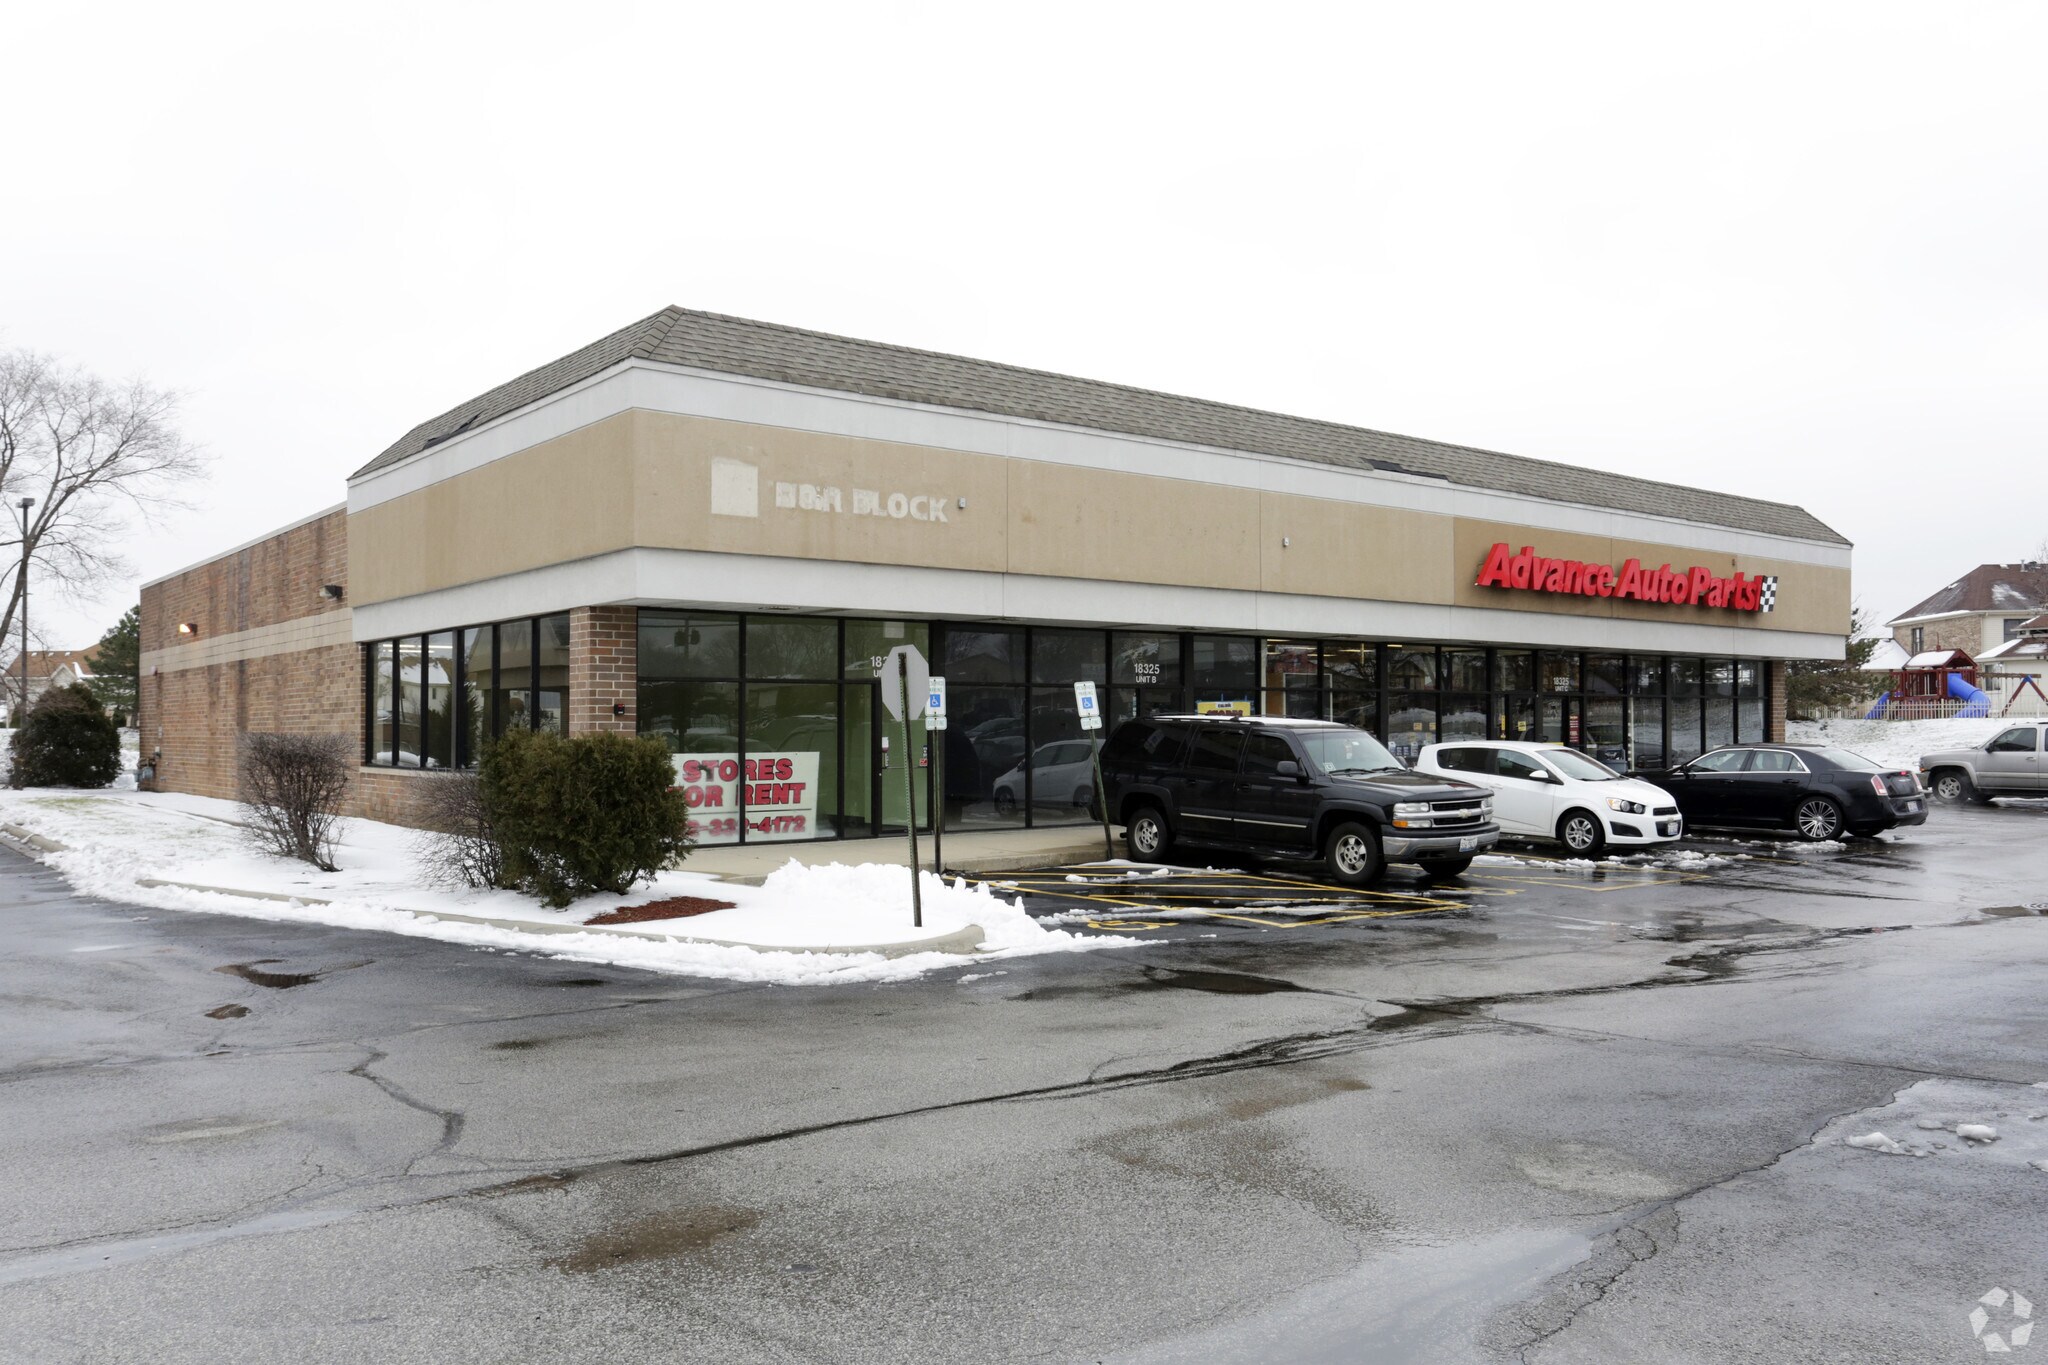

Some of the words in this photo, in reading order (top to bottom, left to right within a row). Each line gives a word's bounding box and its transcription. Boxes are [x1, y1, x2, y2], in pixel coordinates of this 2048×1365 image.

[852, 488, 948, 523] BLOCK
[1477, 543, 1614, 598] Advance
[1612, 558, 1688, 605] Auto
[1688, 566, 1758, 611] Parts
[1134, 663, 1160, 675] 18325
[1135, 675, 1151, 683] UNIT
[1151, 675, 1157, 684] B
[1553, 676, 1570, 686] 18325
[682, 758, 793, 783] STORES
[667, 784, 723, 808] OR
